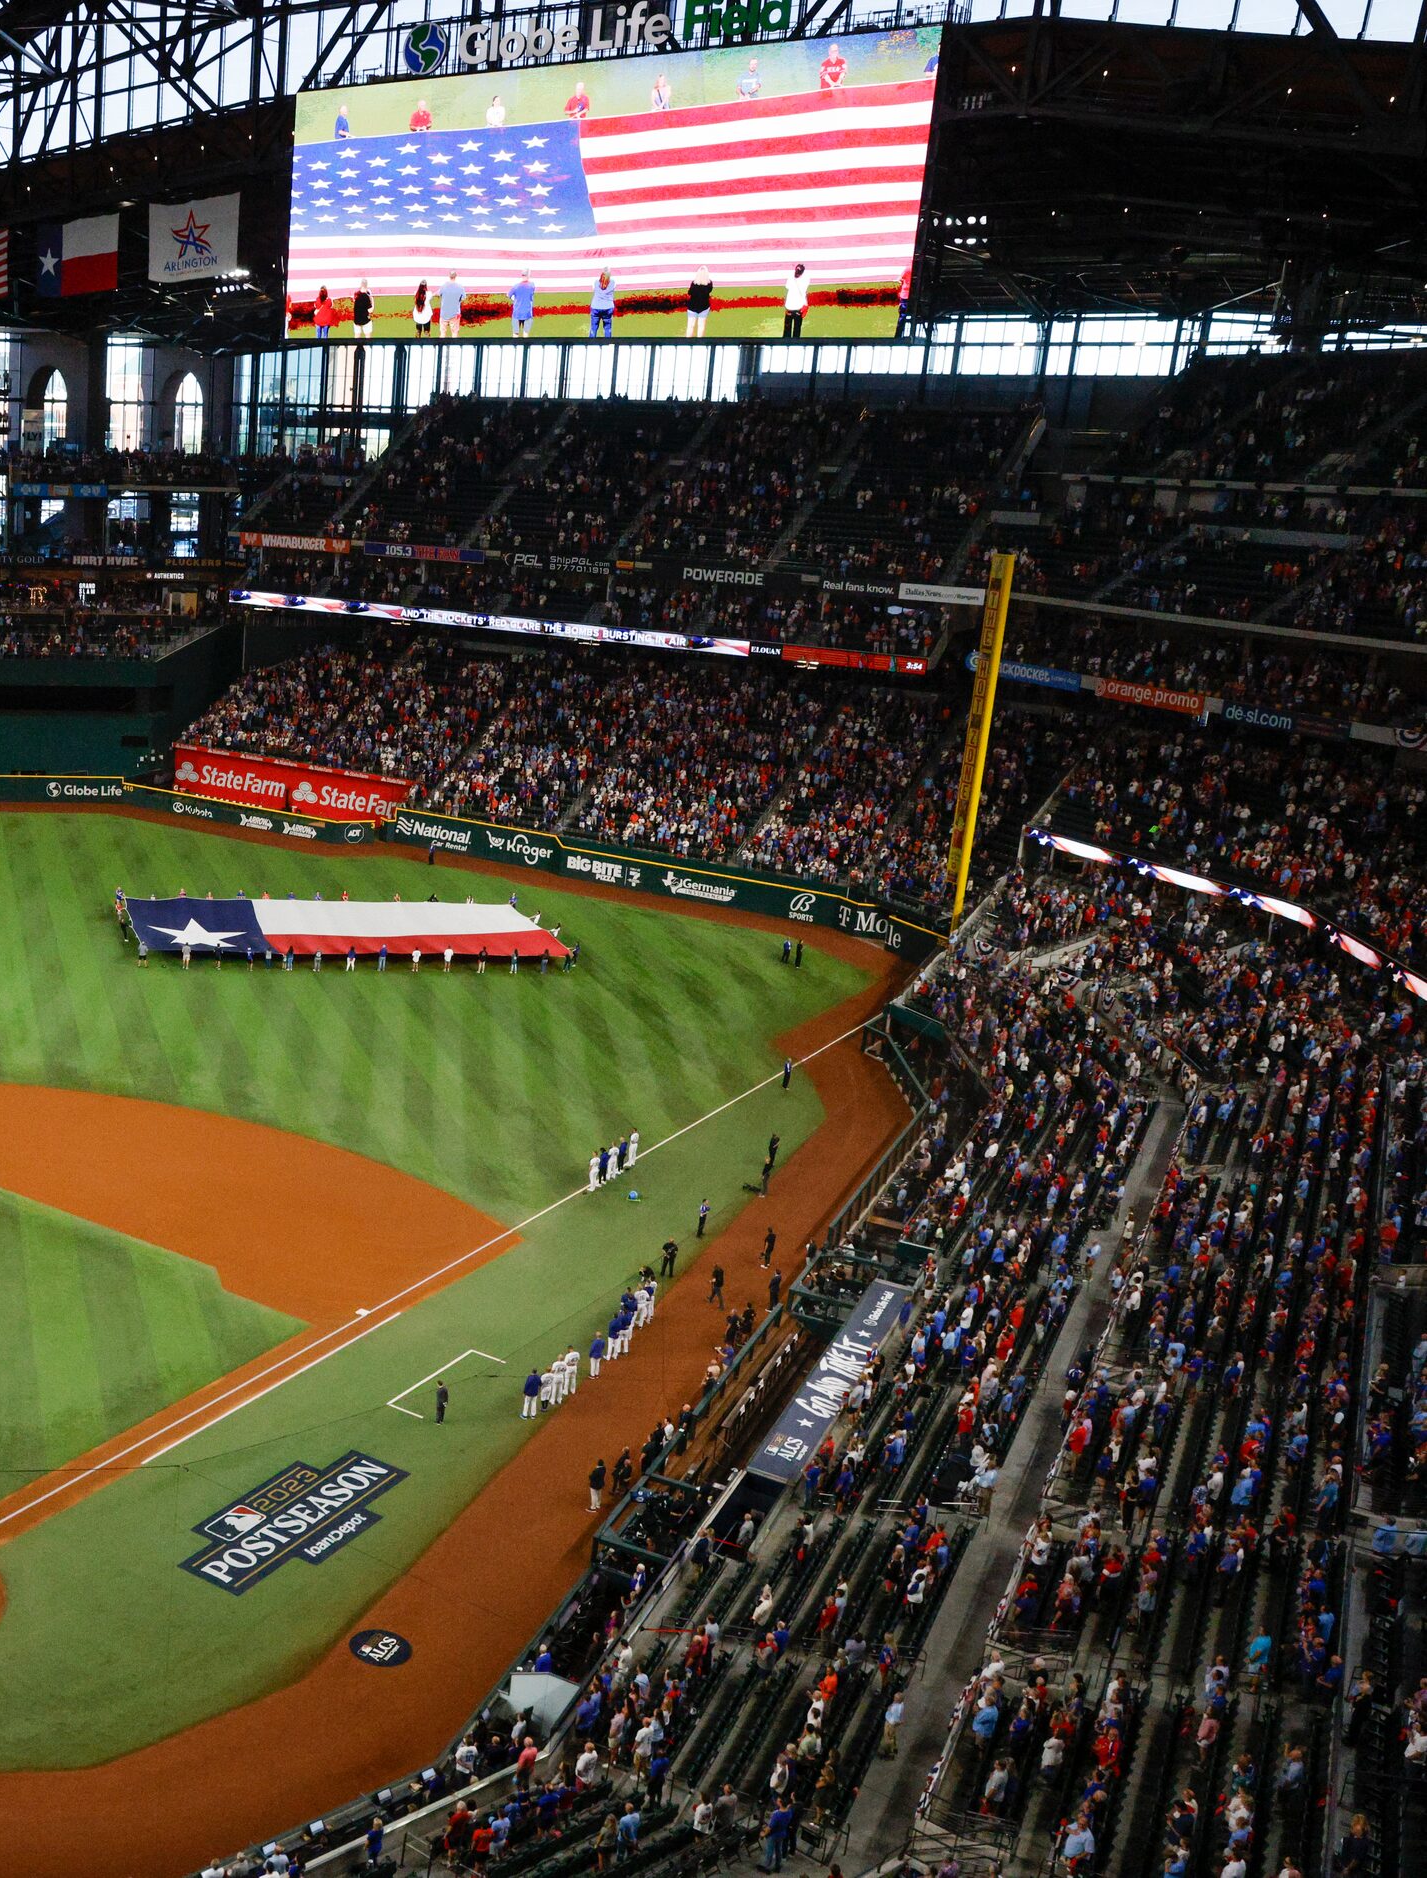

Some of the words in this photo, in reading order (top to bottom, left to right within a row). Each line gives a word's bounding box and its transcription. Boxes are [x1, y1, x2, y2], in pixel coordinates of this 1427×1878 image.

[459, 18, 580, 66] Globe
[590, 1, 671, 51] Life
[683, 0, 792, 41] Field
[164, 256, 218, 272] ARLINGTON
[261, 533, 326, 551] WHATABURGER
[384, 545, 412, 558] 105.3
[17, 556, 45, 564] GOLD
[72, 556, 103, 567] HART
[106, 556, 139, 567] HVAC
[165, 558, 222, 567] PLUCKERS
[513, 553, 543, 567] PGL
[153, 572, 185, 580] AUTHENTICS
[682, 567, 766, 587] POWERADE
[823, 580, 844, 591] Real
[845, 582, 865, 593] fans
[866, 584, 895, 595] know.
[400, 608, 420, 619] AND
[422, 610, 440, 622] THE
[442, 612, 487, 626] ROCKETS'
[489, 617, 507, 628] RED
[509, 619, 541, 632] GLARE
[543, 622, 563, 633] THE
[564, 625, 600, 639] BOMBS
[602, 629, 653, 643] BURSTING
[654, 635, 665, 646] IN
[668, 636, 687, 647] AIR
[751, 645, 782, 656] ELOUAN
[905, 661, 924, 671] 3:54
[1107, 682, 1200, 709] orange.promo
[63, 784, 98, 797] Globe
[100, 785, 123, 797] Life
[184, 804, 213, 819] Kubota
[249, 815, 269, 826] ARROW
[292, 823, 313, 833] ARROW
[346, 829, 362, 837] ADT
[431, 839, 444, 849] Car
[445, 841, 468, 852] Rental
[506, 834, 554, 865] Kroger
[592, 861, 623, 879] BITE
[595, 873, 616, 883] PIZZA
[683, 878, 736, 898] Germania
[685, 889, 726, 901] INSURANCE
[788, 911, 814, 922] SPORTS
[780, 1436, 804, 1462] ALCS
[252, 1469, 319, 1512] 2023
[200, 1459, 389, 1584] POSTSEASON
[304, 1512, 367, 1558] loanDepot
[368, 1636, 397, 1662] ALCS
